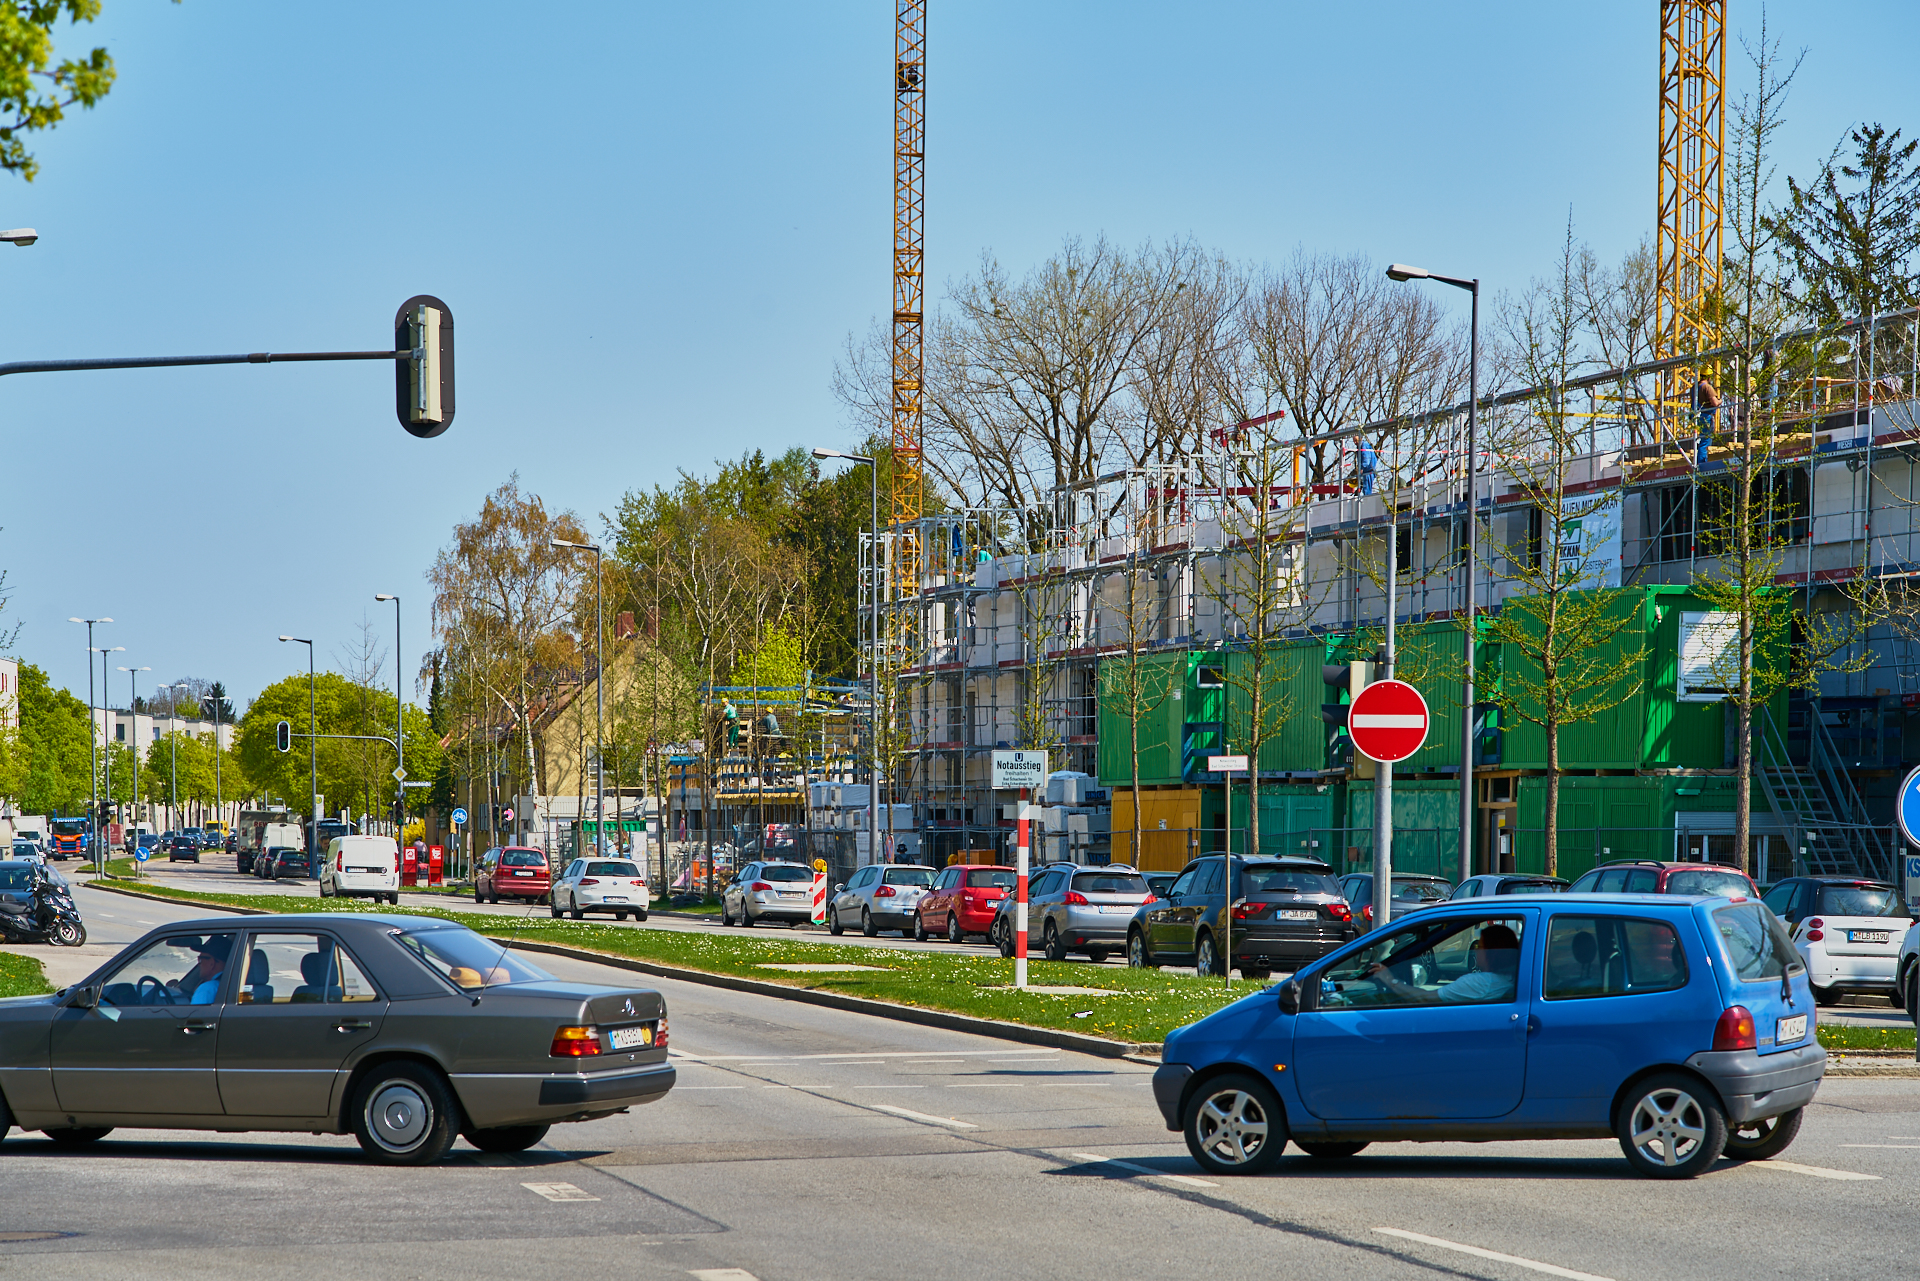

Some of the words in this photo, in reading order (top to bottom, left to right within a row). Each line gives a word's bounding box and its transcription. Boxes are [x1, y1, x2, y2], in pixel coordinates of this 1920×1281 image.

[1837, 440, 1852, 449] WIESER
[997, 760, 1041, 772] Notausstieg
[1720, 781, 1738, 789] 448
